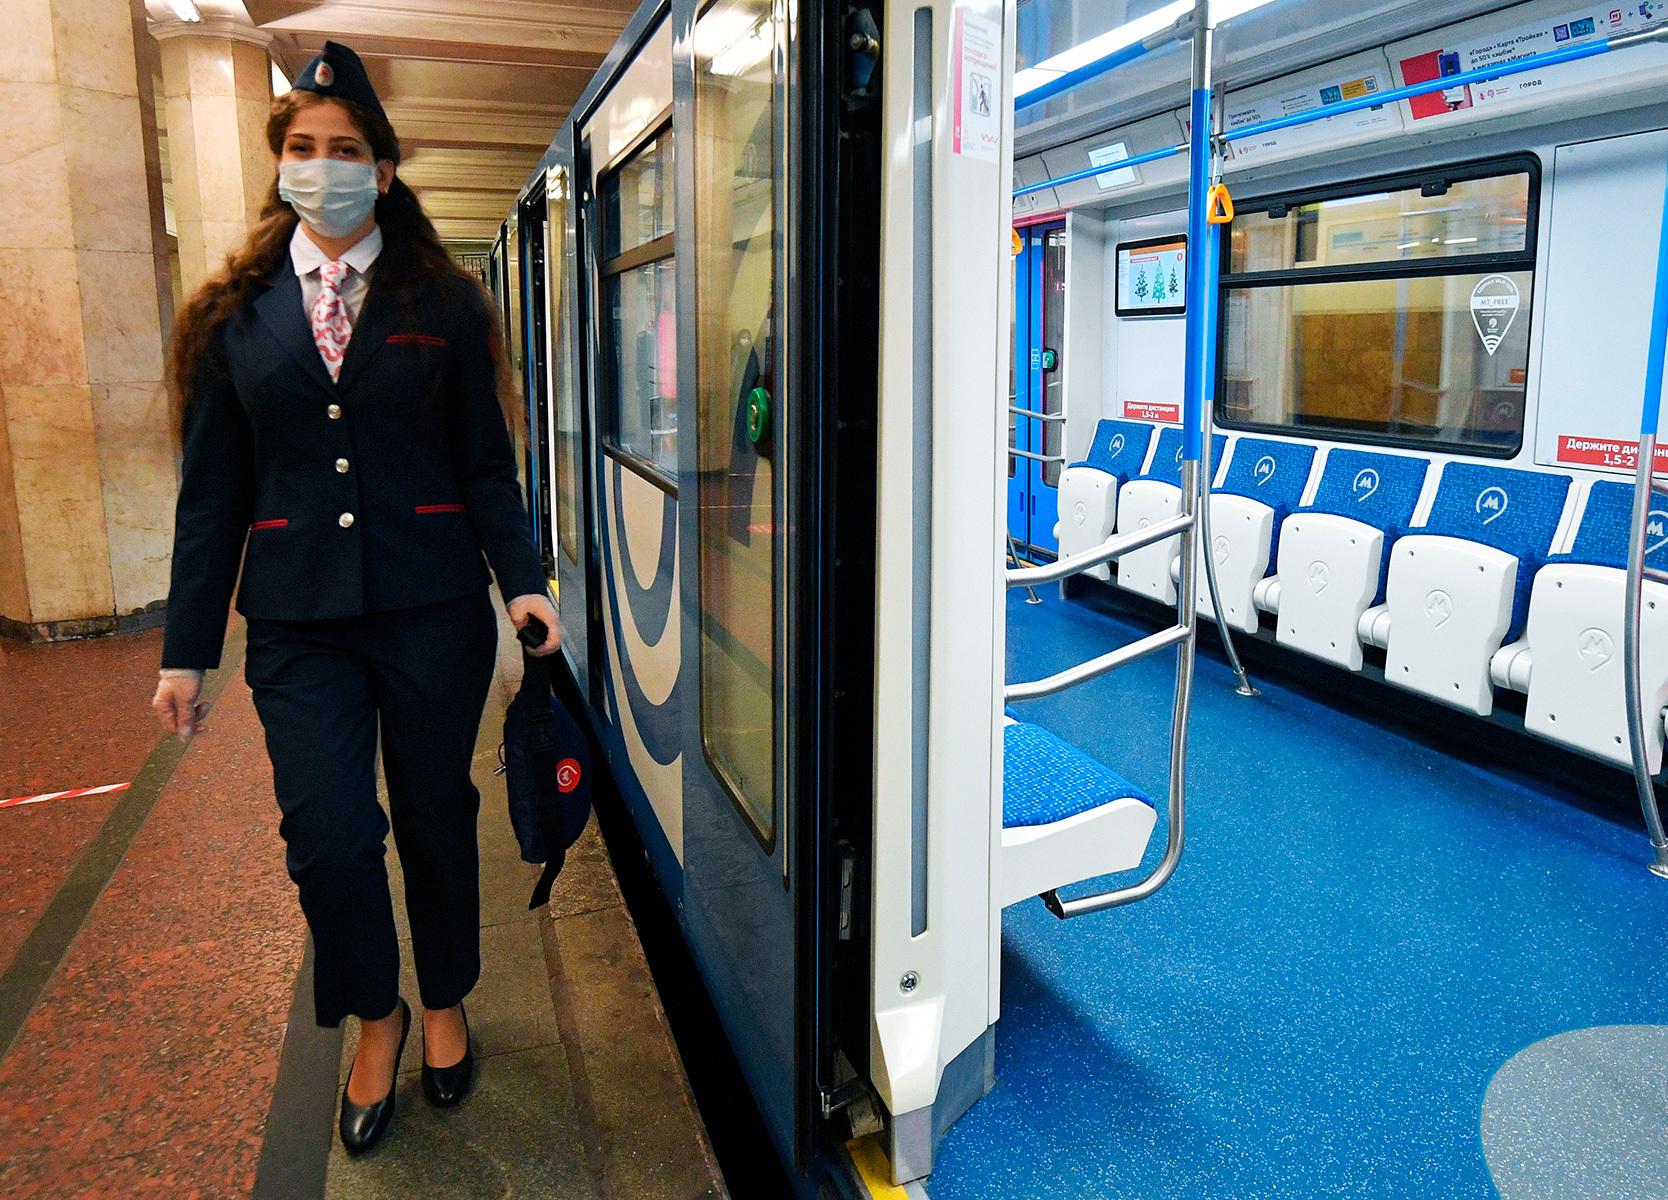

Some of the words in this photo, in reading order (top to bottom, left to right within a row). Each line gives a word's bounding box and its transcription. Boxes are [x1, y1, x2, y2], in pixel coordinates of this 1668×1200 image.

[1497, 39, 1515, 49] Карта
[1479, 53, 1491, 61] 50%
[1519, 79, 1543, 89] ГОРОД
[1480, 298, 1509, 307] MT_FREE
[1566, 438, 1620, 453] Держите
[1603, 453, 1635, 467] 1,5-2
